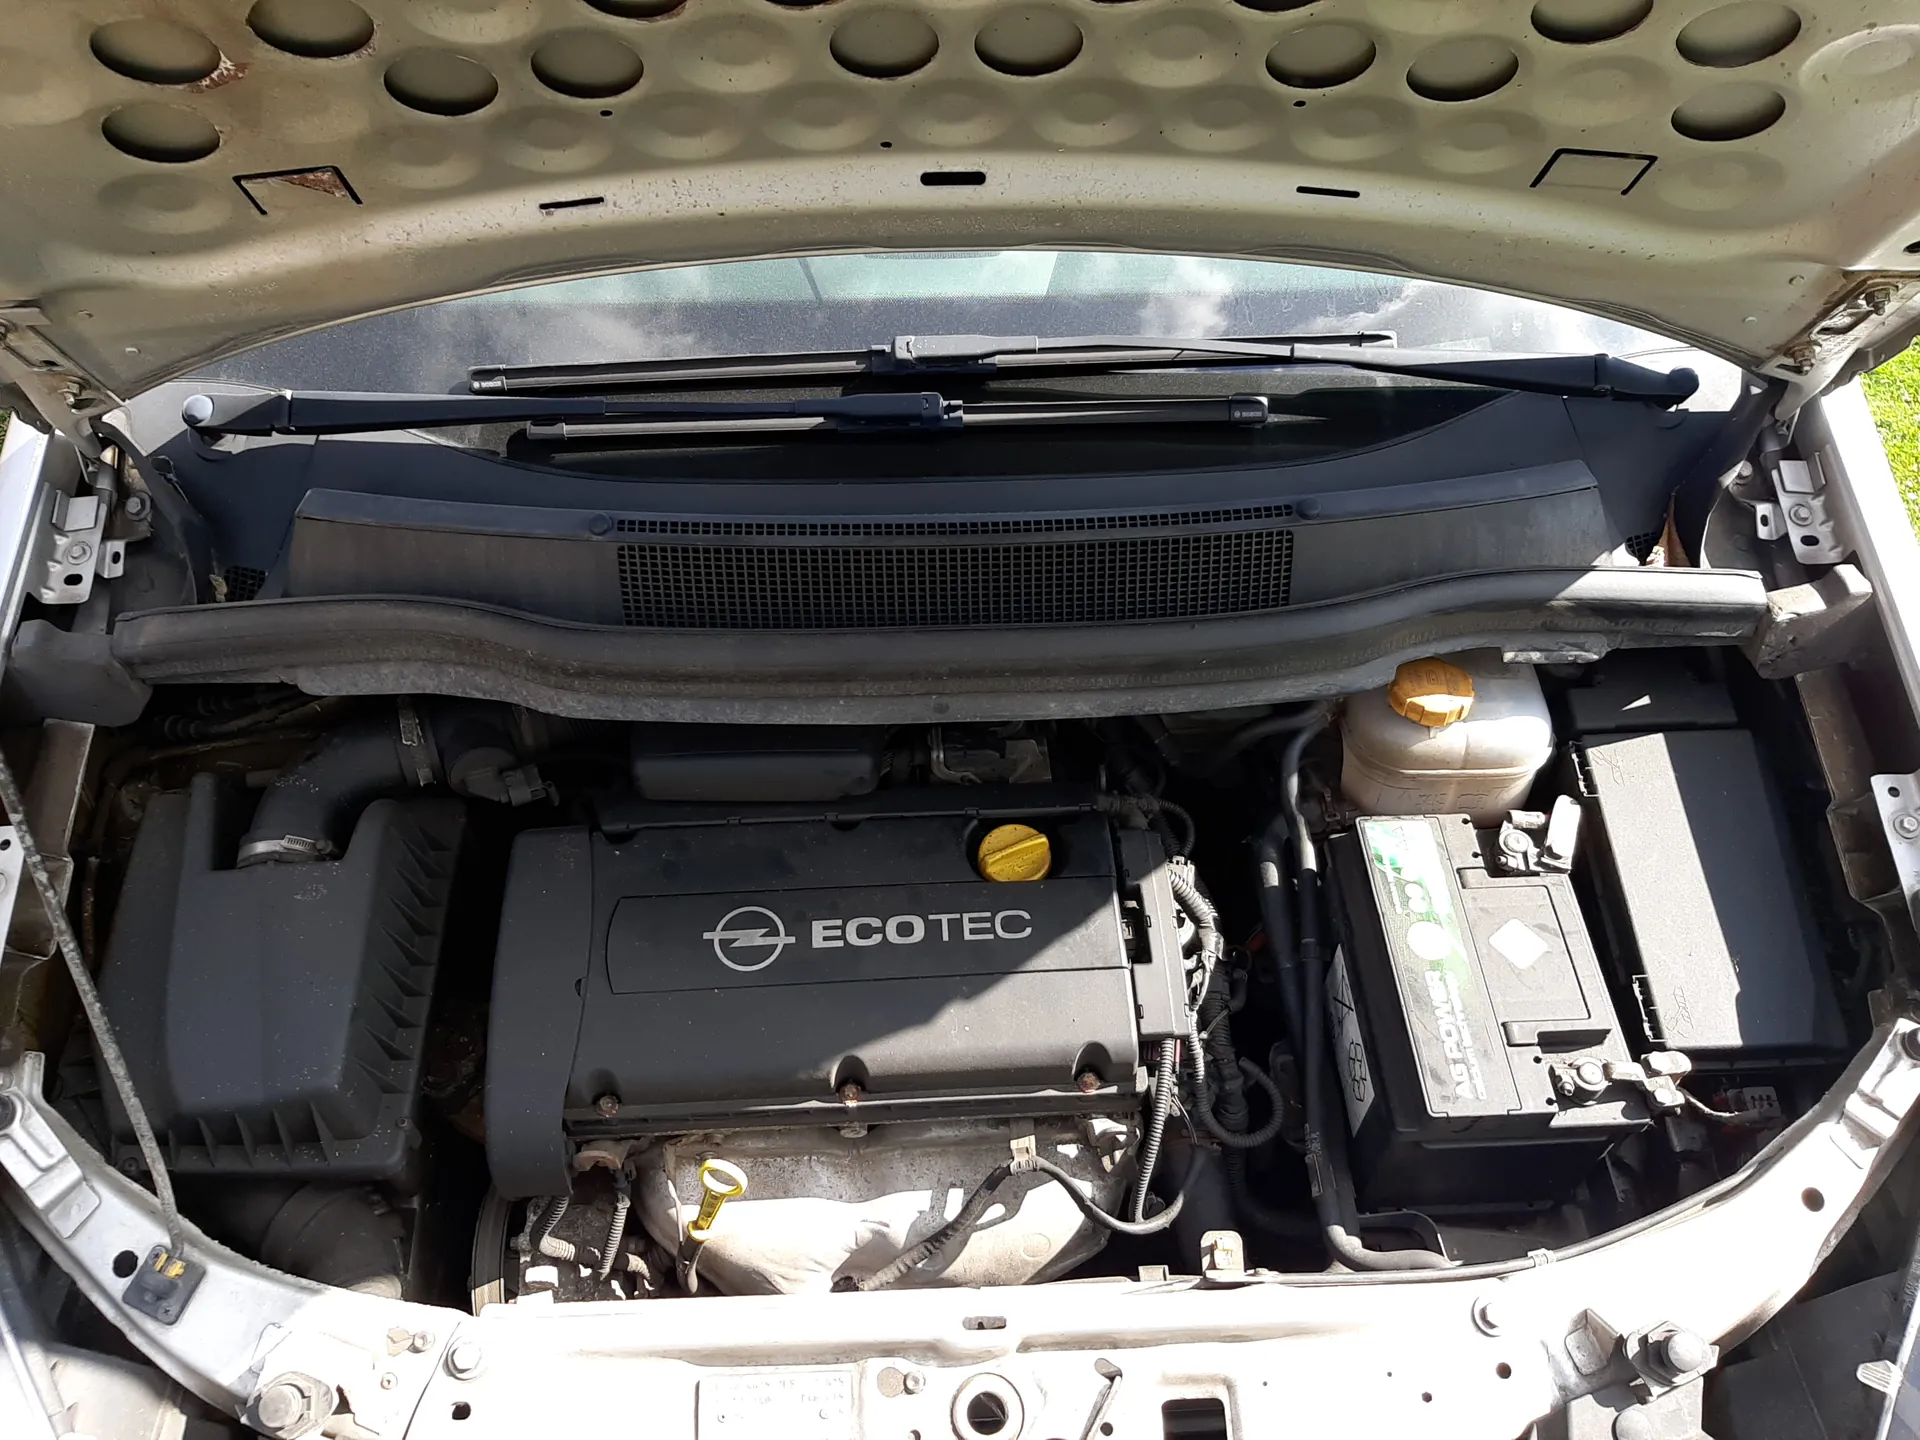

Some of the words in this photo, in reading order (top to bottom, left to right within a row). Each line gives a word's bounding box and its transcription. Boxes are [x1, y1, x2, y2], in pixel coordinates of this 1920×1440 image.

[811, 909, 1033, 949] ECOTEC
[1424, 970, 1462, 1059] POWER
[1449, 1063, 1473, 1099] AG
